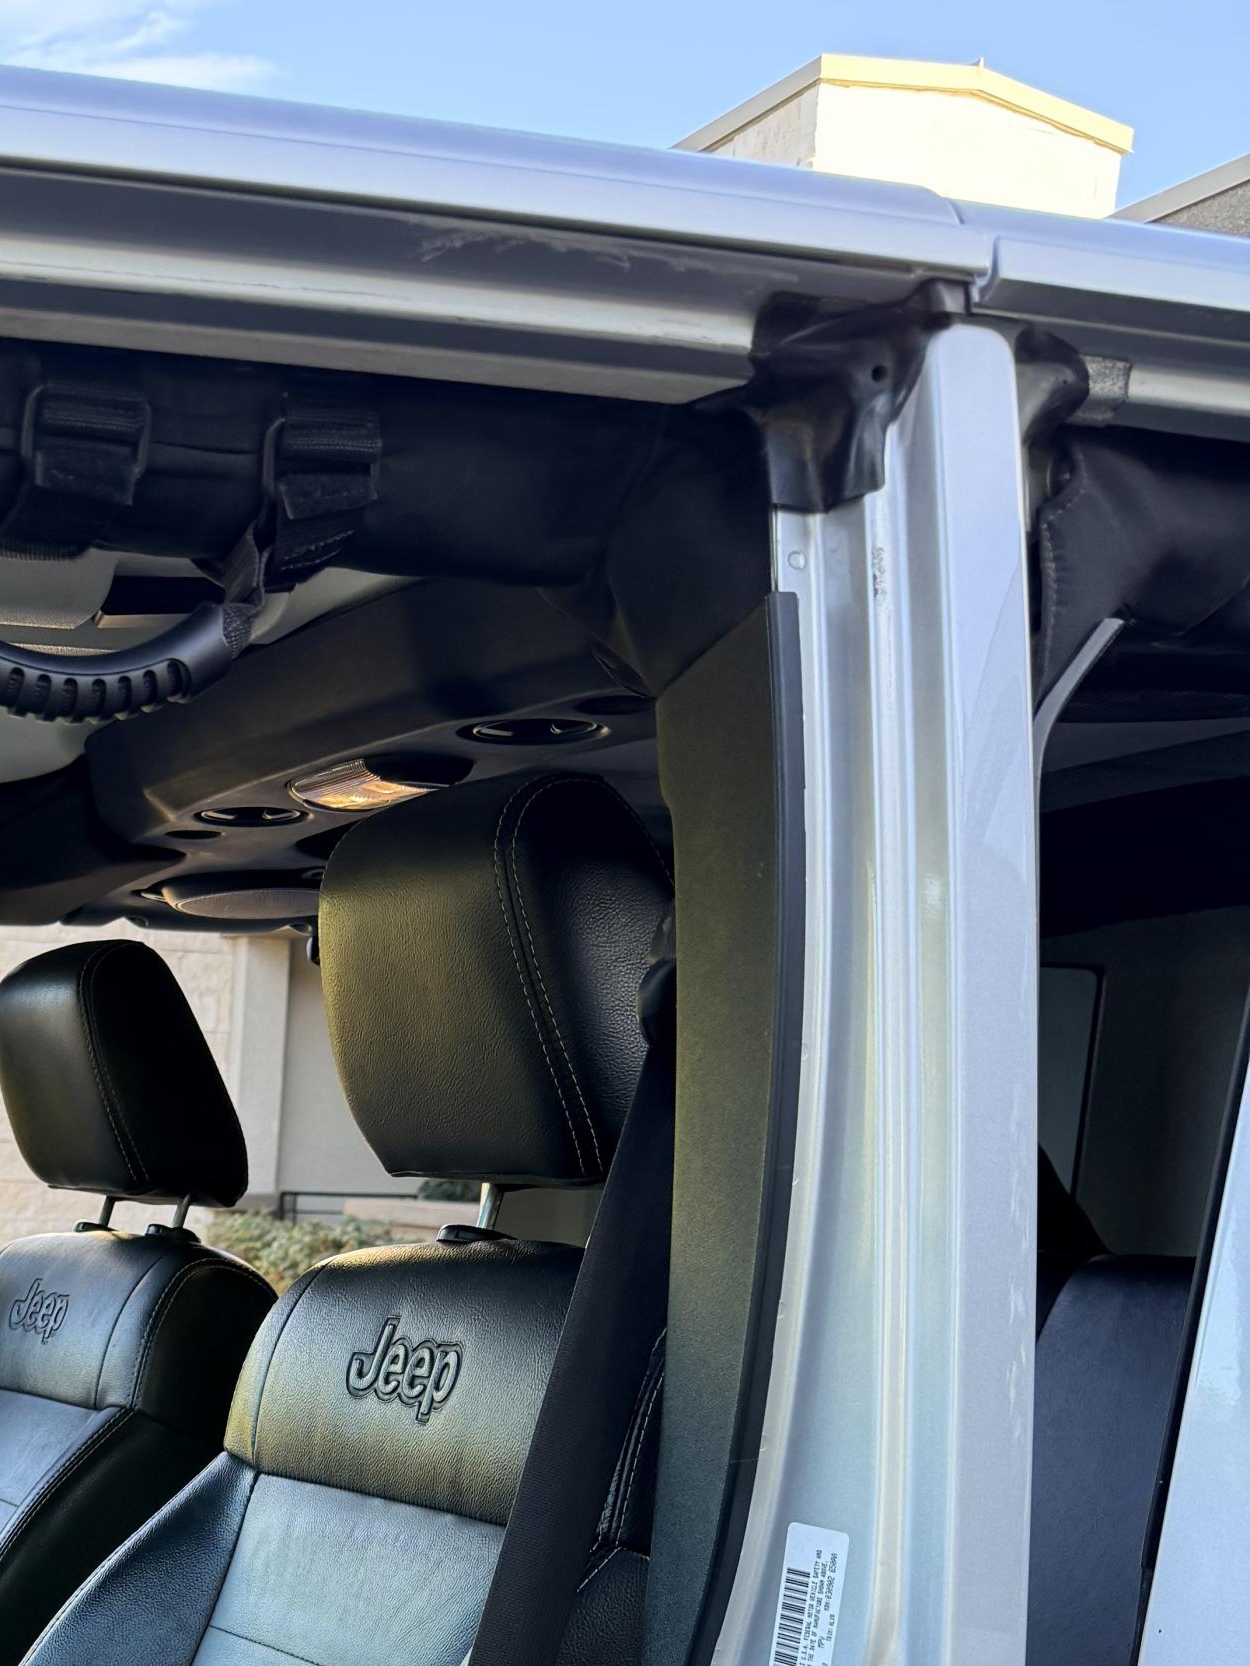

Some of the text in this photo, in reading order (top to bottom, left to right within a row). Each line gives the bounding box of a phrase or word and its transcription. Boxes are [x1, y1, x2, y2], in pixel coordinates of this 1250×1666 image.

[9, 1278, 69, 1342] Jeep
[348, 1316, 462, 1424] Jeep
[816, 1635, 825, 1649] MPV
